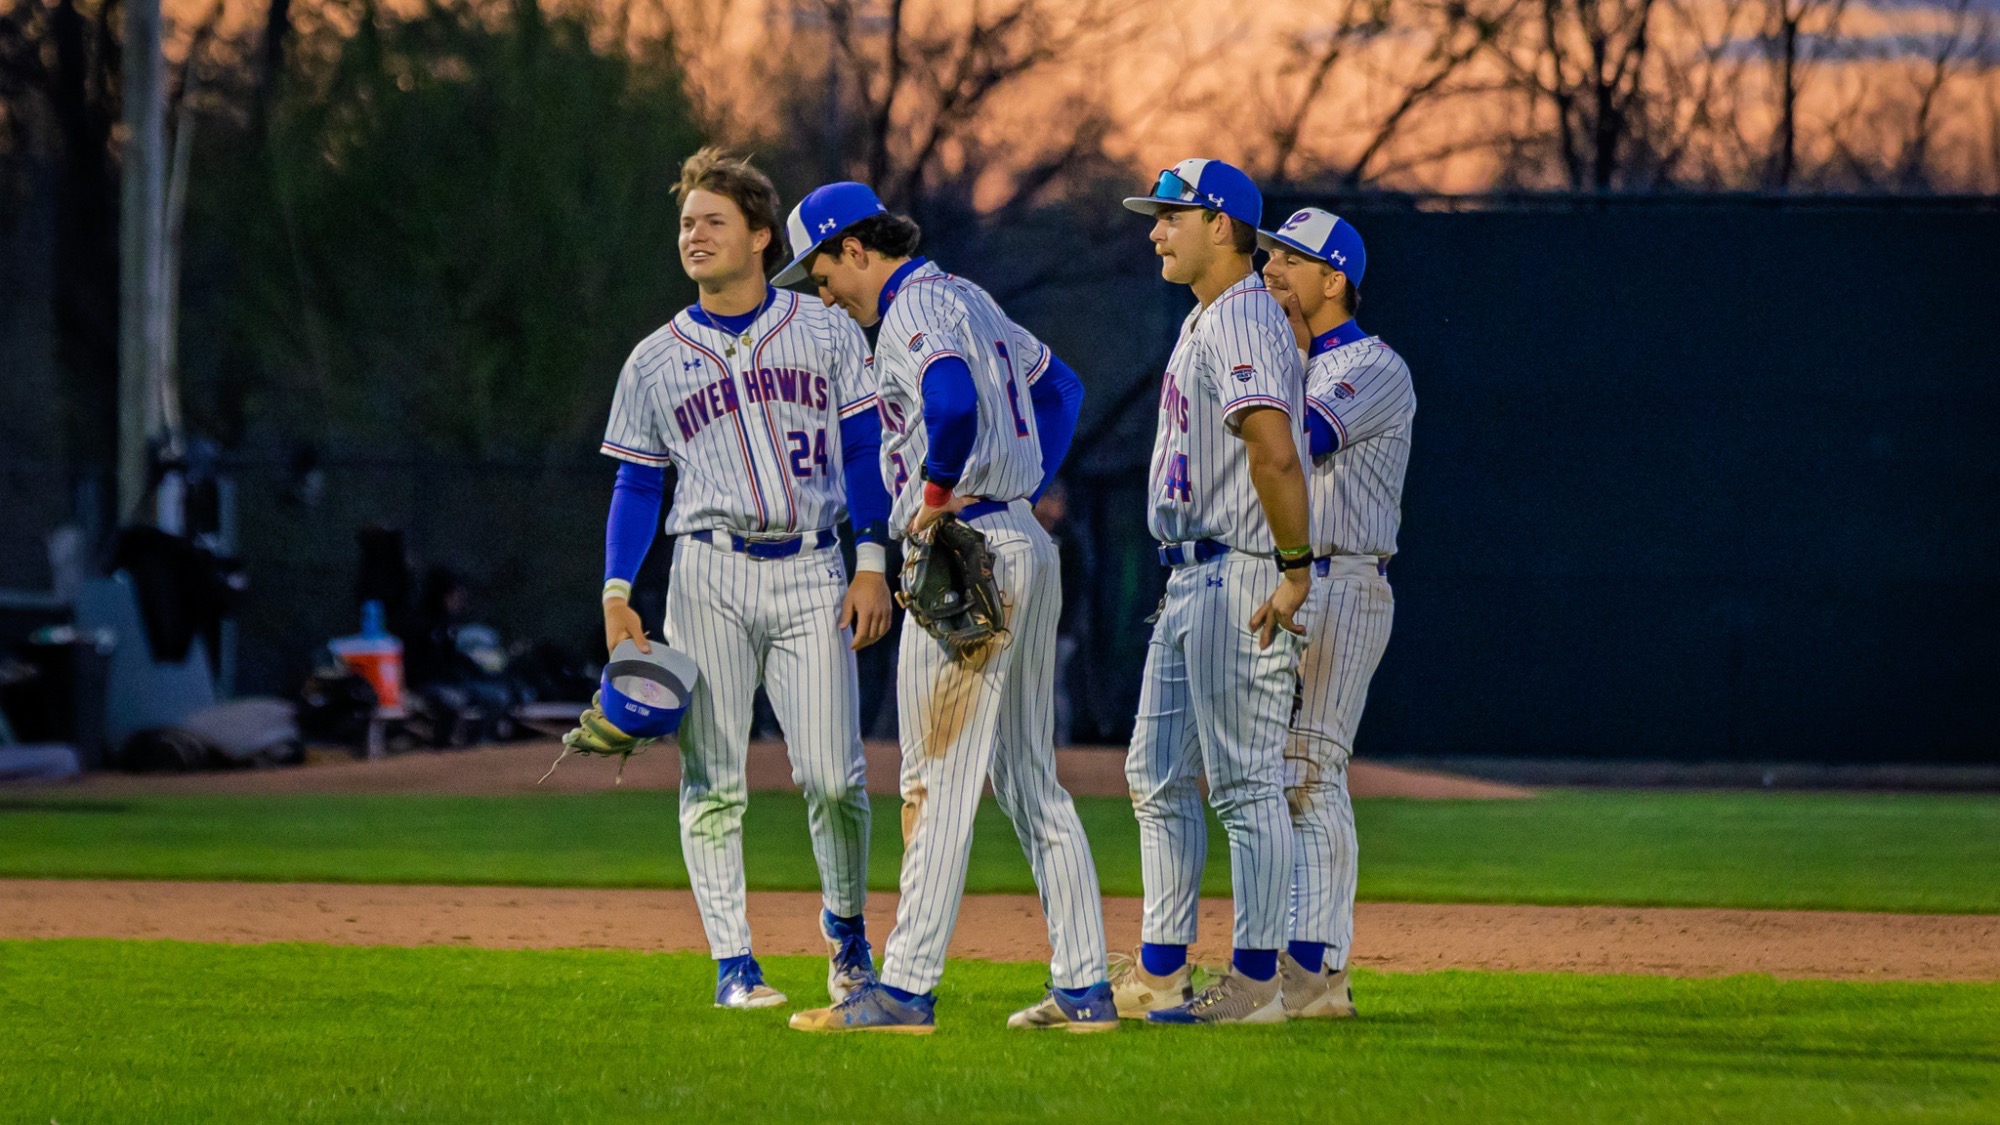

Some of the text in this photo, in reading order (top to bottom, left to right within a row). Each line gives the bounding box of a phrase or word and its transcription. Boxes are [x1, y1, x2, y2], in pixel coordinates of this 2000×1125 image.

[674, 367, 828, 443] RIVER HAWKS
[787, 428, 828, 477] 24
